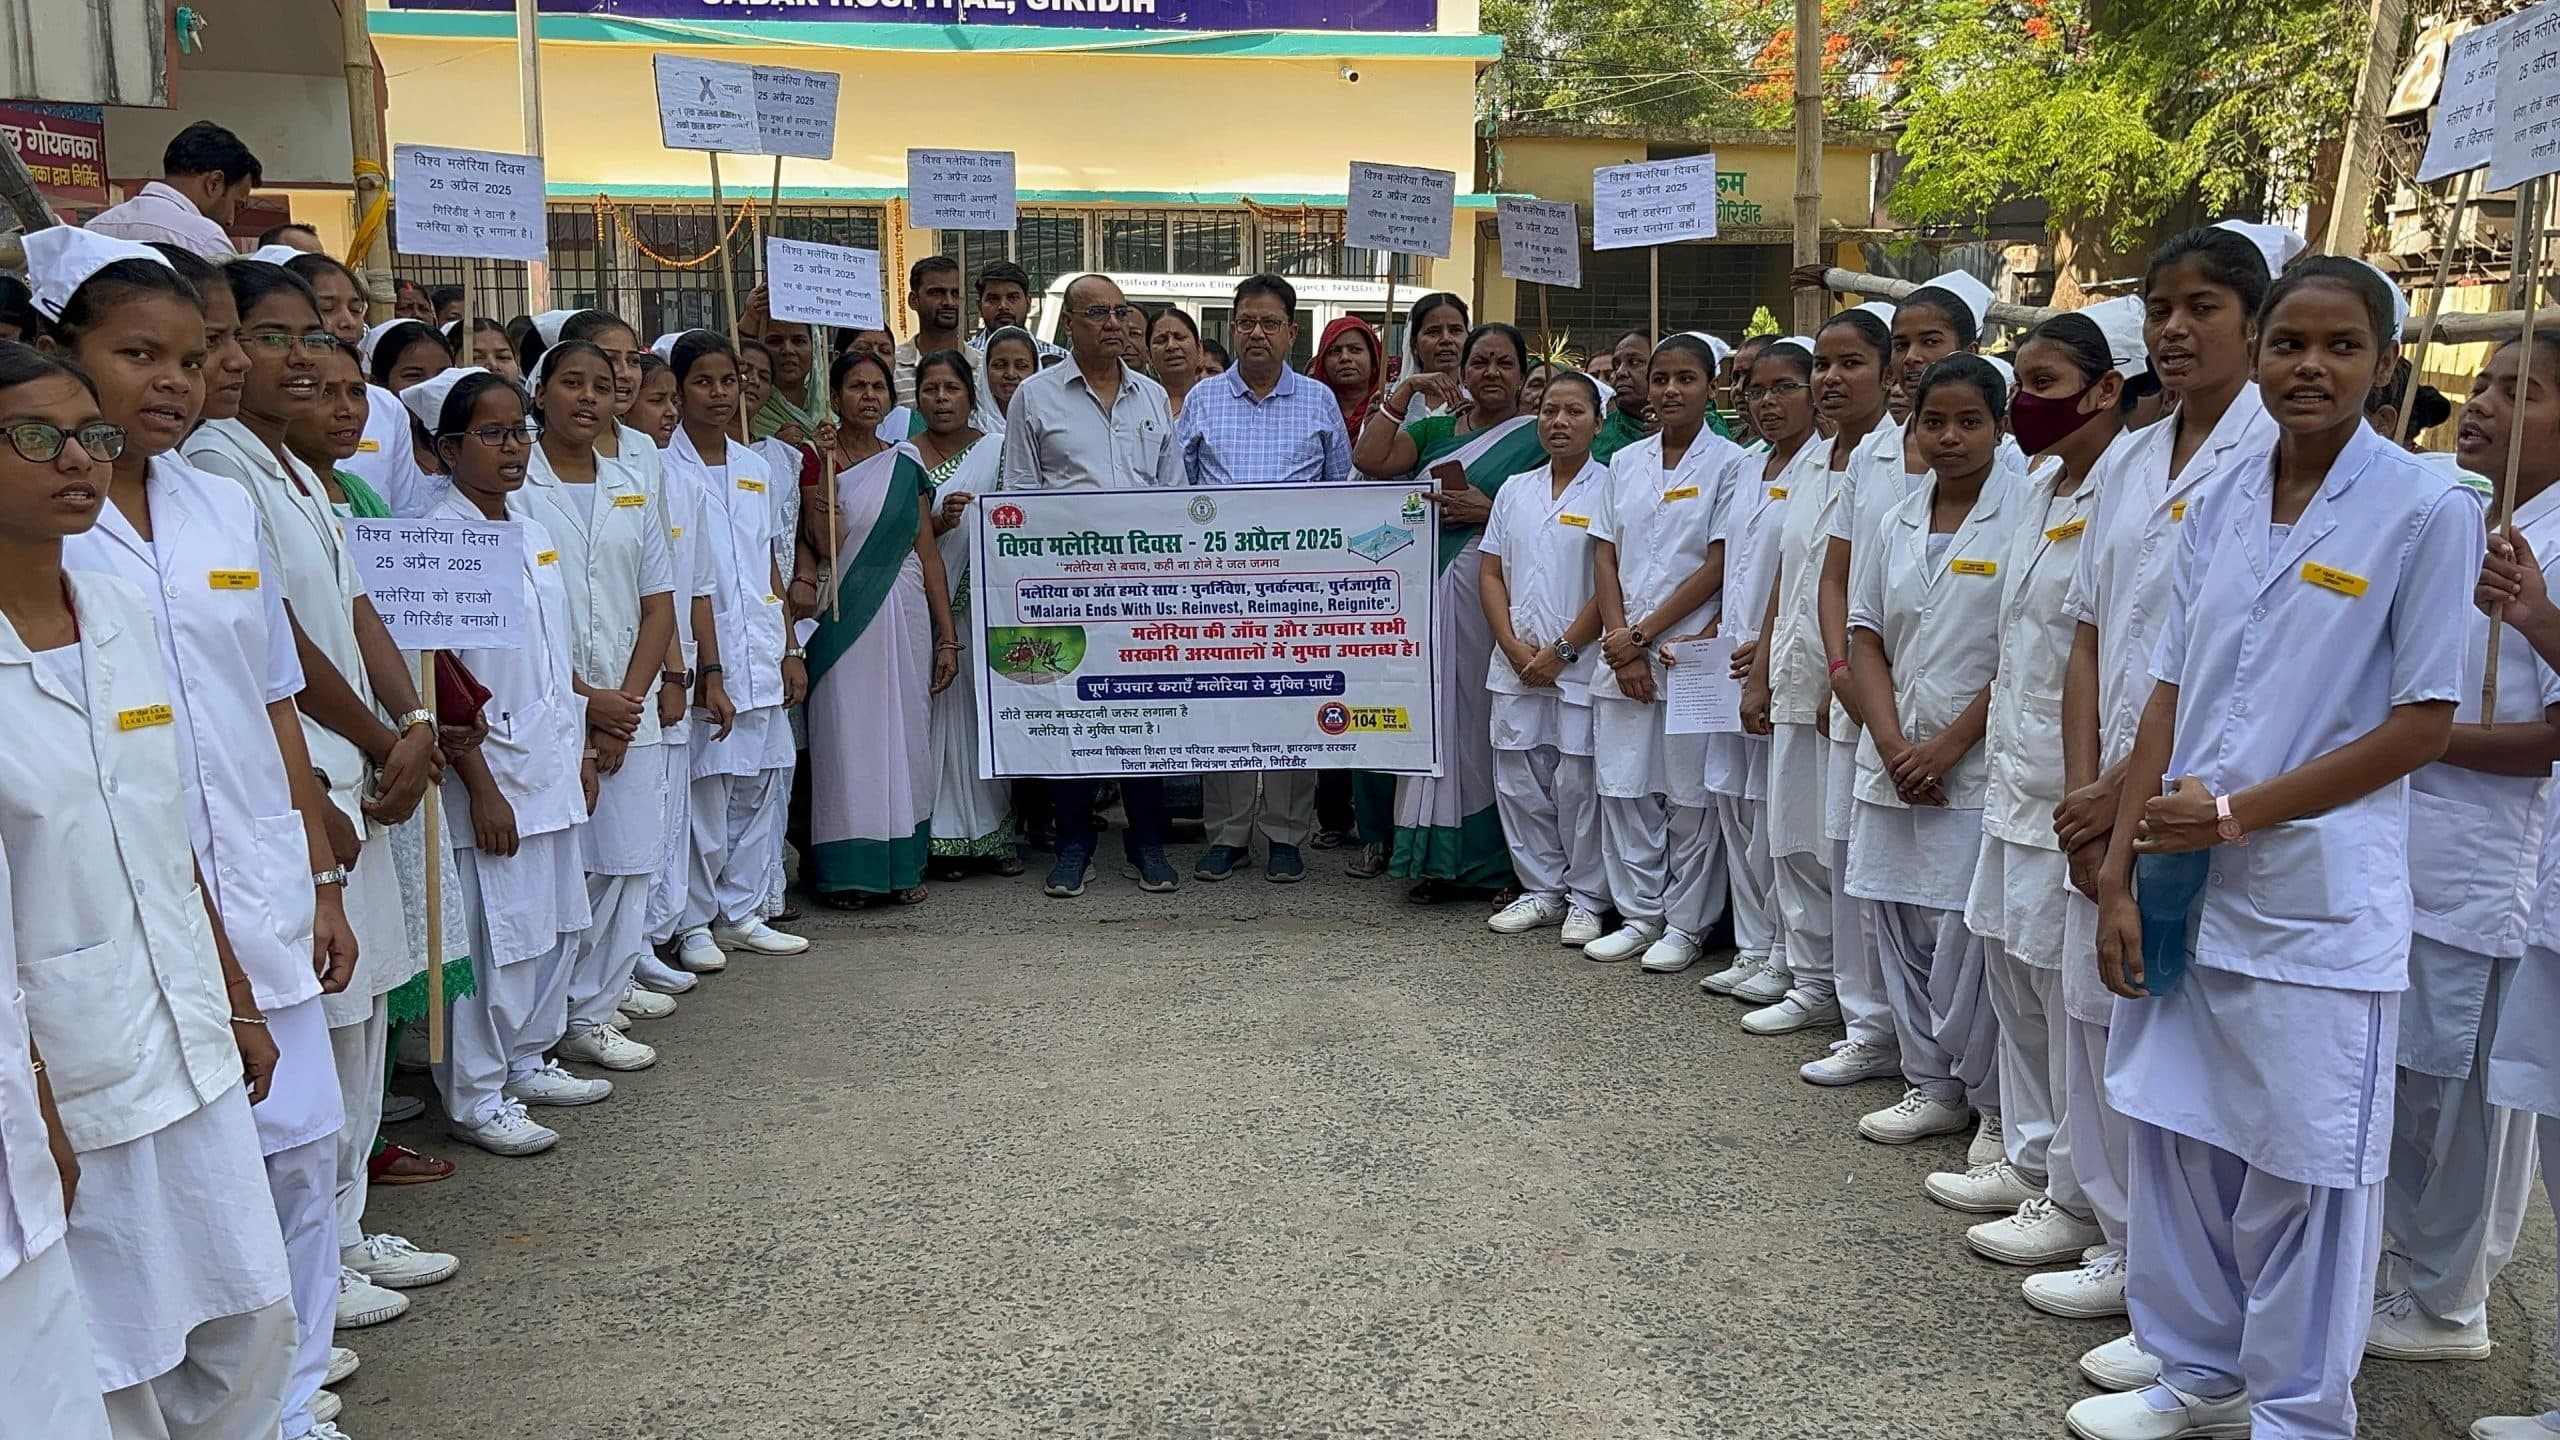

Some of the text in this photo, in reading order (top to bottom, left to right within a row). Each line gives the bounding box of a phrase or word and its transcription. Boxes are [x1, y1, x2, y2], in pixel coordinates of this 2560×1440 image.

[2512, 29, 2530, 51] विश्व
[2519, 49, 2558, 81] 25 अप्रैल
[773, 74, 826, 89] मलेरिया दिवस
[2464, 70, 2474, 85] 25
[758, 91, 814, 105] 25 अप्रैल 2025
[25, 120, 98, 161] गोयनका
[414, 152, 525, 175] विश्व मलेरिया दिवस
[922, 154, 1001, 167] विश्व मलेरिया दिवस
[52, 163, 100, 188] द्वारा निर्मित
[948, 171, 968, 181] अप्रैल
[972, 174, 992, 182] 2025
[1364, 169, 1443, 188] विश्व मलेरिया दिवस
[1609, 164, 1699, 183] विश्व मलेरिया दिवस
[430, 178, 512, 195] 25 अप्रैल 2025
[1621, 183, 1688, 198] 25 अप्रैल 2025
[932, 192, 966, 202] सावधानी
[1372, 190, 1431, 204] 25 अप्रैल 2025
[433, 203, 517, 222] गिरिडीह ने ठाना है
[936, 207, 965, 218] मलेरिया
[1618, 207, 1637, 220] पानी
[1642, 205, 1672, 217] ठहरेगा
[416, 220, 516, 238] मलेरिया को दूर भगाना
[1515, 222, 1559, 235] 25 2025
[1613, 221, 1674, 236] मच्छर पनपेगा
[782, 244, 865, 265] विश्व मलेरिया दिवस
[793, 264, 856, 279] 25 अप्रैल 2025
[356, 525, 500, 546] विश्व मलेरिया दिवस
[997, 532, 1044, 557] विश्व
[1048, 531, 1124, 555] मलेरिया
[1128, 530, 1183, 554] दिवस
[1204, 531, 1227, 553] 25
[1234, 526, 1291, 552] अप्रैल
[1296, 528, 1342, 550] 2025
[376, 552, 482, 571] 25 अप्रैल 2025
[1107, 560, 1116, 572] से
[1120, 561, 1150, 573] बचाव,
[1177, 561, 1189, 570] ना
[1194, 557, 1212, 570] होने
[1227, 560, 1246, 569] जल
[1250, 558, 1280, 568] जमाव
[374, 587, 492, 604] मलेरिया को हराओ
[1020, 584, 1068, 599] मलेरिया
[1072, 587, 1090, 598] का
[1094, 583, 1115, 598] अंत
[1119, 583, 1148, 597] हमारे
[1024, 597, 1395, 618] "Malaria Ends With Us: Reinvest, Reimagine, Reignite".
[404, 611, 453, 626] गिरिडीह
[1131, 618, 1406, 640] मलेरिया की जाँच और उपचार सभी
[1118, 644, 1179, 662] सरकारी
[1185, 642, 1267, 661] अस्पतालों
[1272, 641, 1287, 658] में
[1291, 644, 1331, 663] मुफ्त
[1336, 643, 1398, 658] उपलब्ध
[1088, 674, 1334, 698] पूर्ण उपचार कराएँ मलेरिया से मुक्ति पाएँ
[999, 704, 1188, 720] सोते समय मच्छरदानी जरूर लगाना है
[1352, 714, 1377, 728] 104
[1382, 715, 1397, 724] पर
[1028, 722, 1142, 738] मलेरिया से मुक्ति पाना
[1106, 743, 1357, 756] चिकित्सा शिक्षा परिवार कल्याण विभाग, झारखण्ड सरकार
[1122, 756, 1307, 770] जिला मलेरिया नियंत्रण समिति, गिरिडीह
